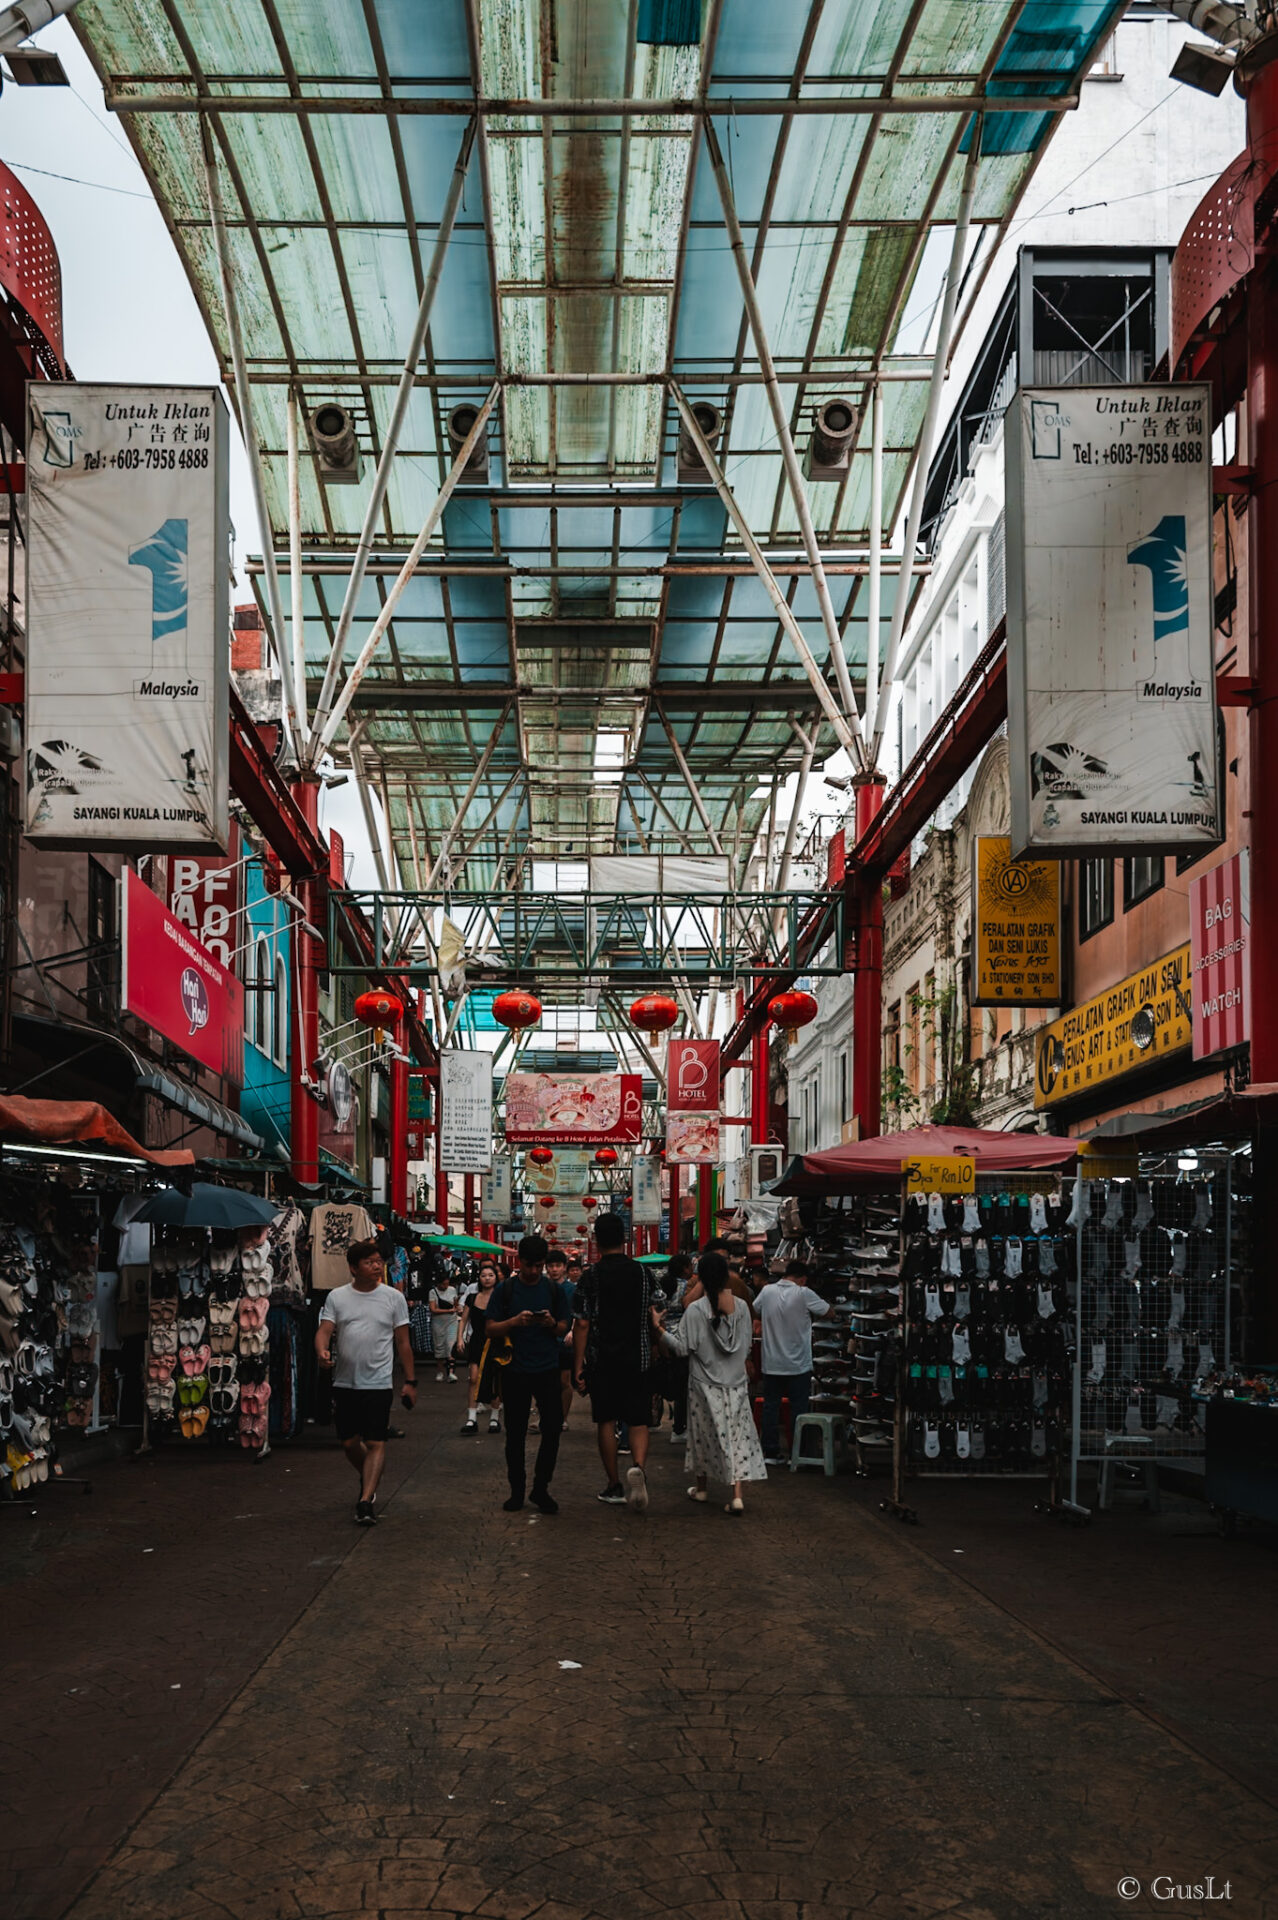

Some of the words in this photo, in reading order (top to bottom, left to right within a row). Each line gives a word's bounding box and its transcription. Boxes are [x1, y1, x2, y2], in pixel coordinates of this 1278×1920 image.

[105, 403, 159, 420] Untuk
[163, 403, 210, 420] Iklan
[1096, 397, 1150, 414] Untuk
[1155, 396, 1202, 413] Iklan
[127, 423, 210, 443] 广告查询
[1120, 417, 1202, 438] 广告查询
[109, 448, 176, 470] +603-7958
[178, 448, 209, 469] 4888
[1102, 443, 1169, 464] +603-7958
[1172, 442, 1202, 463] 4888
[140, 679, 199, 699] Malaysia
[1143, 680, 1202, 700] Malaysia
[73, 807, 120, 820] SAYANGI
[123, 807, 160, 820] KUALA
[1081, 812, 1127, 824] SAYANGI
[1131, 812, 1167, 824] KUALA
[1171, 812, 1216, 829] LUMPUR
[1205, 898, 1232, 929] BAG
[982, 922, 1025, 937] PERALATAN
[1028, 922, 1055, 937] GRAFIK
[989, 939, 1004, 953] DAN
[1007, 939, 1023, 953] SENI
[1026, 939, 1048, 953] LUKIS
[1196, 937, 1246, 972] ACCESSORIES
[183, 971, 199, 999] Hari
[989, 972, 1025, 984] STATIONERY
[1027, 972, 1040, 984] SDN
[192, 998, 207, 1025] Hari
[1063, 1002, 1104, 1042] PERALATAN
[1107, 983, 1136, 1022] GRAFIK
[1140, 970, 1158, 1005] DAN
[1201, 988, 1241, 1019] WATCH
[1088, 1030, 1105, 1060] ART
[1156, 998, 1171, 1027] SDN
[678, 1090, 706, 1098] HOTEL
[535, 1135, 556, 1143] Datang
